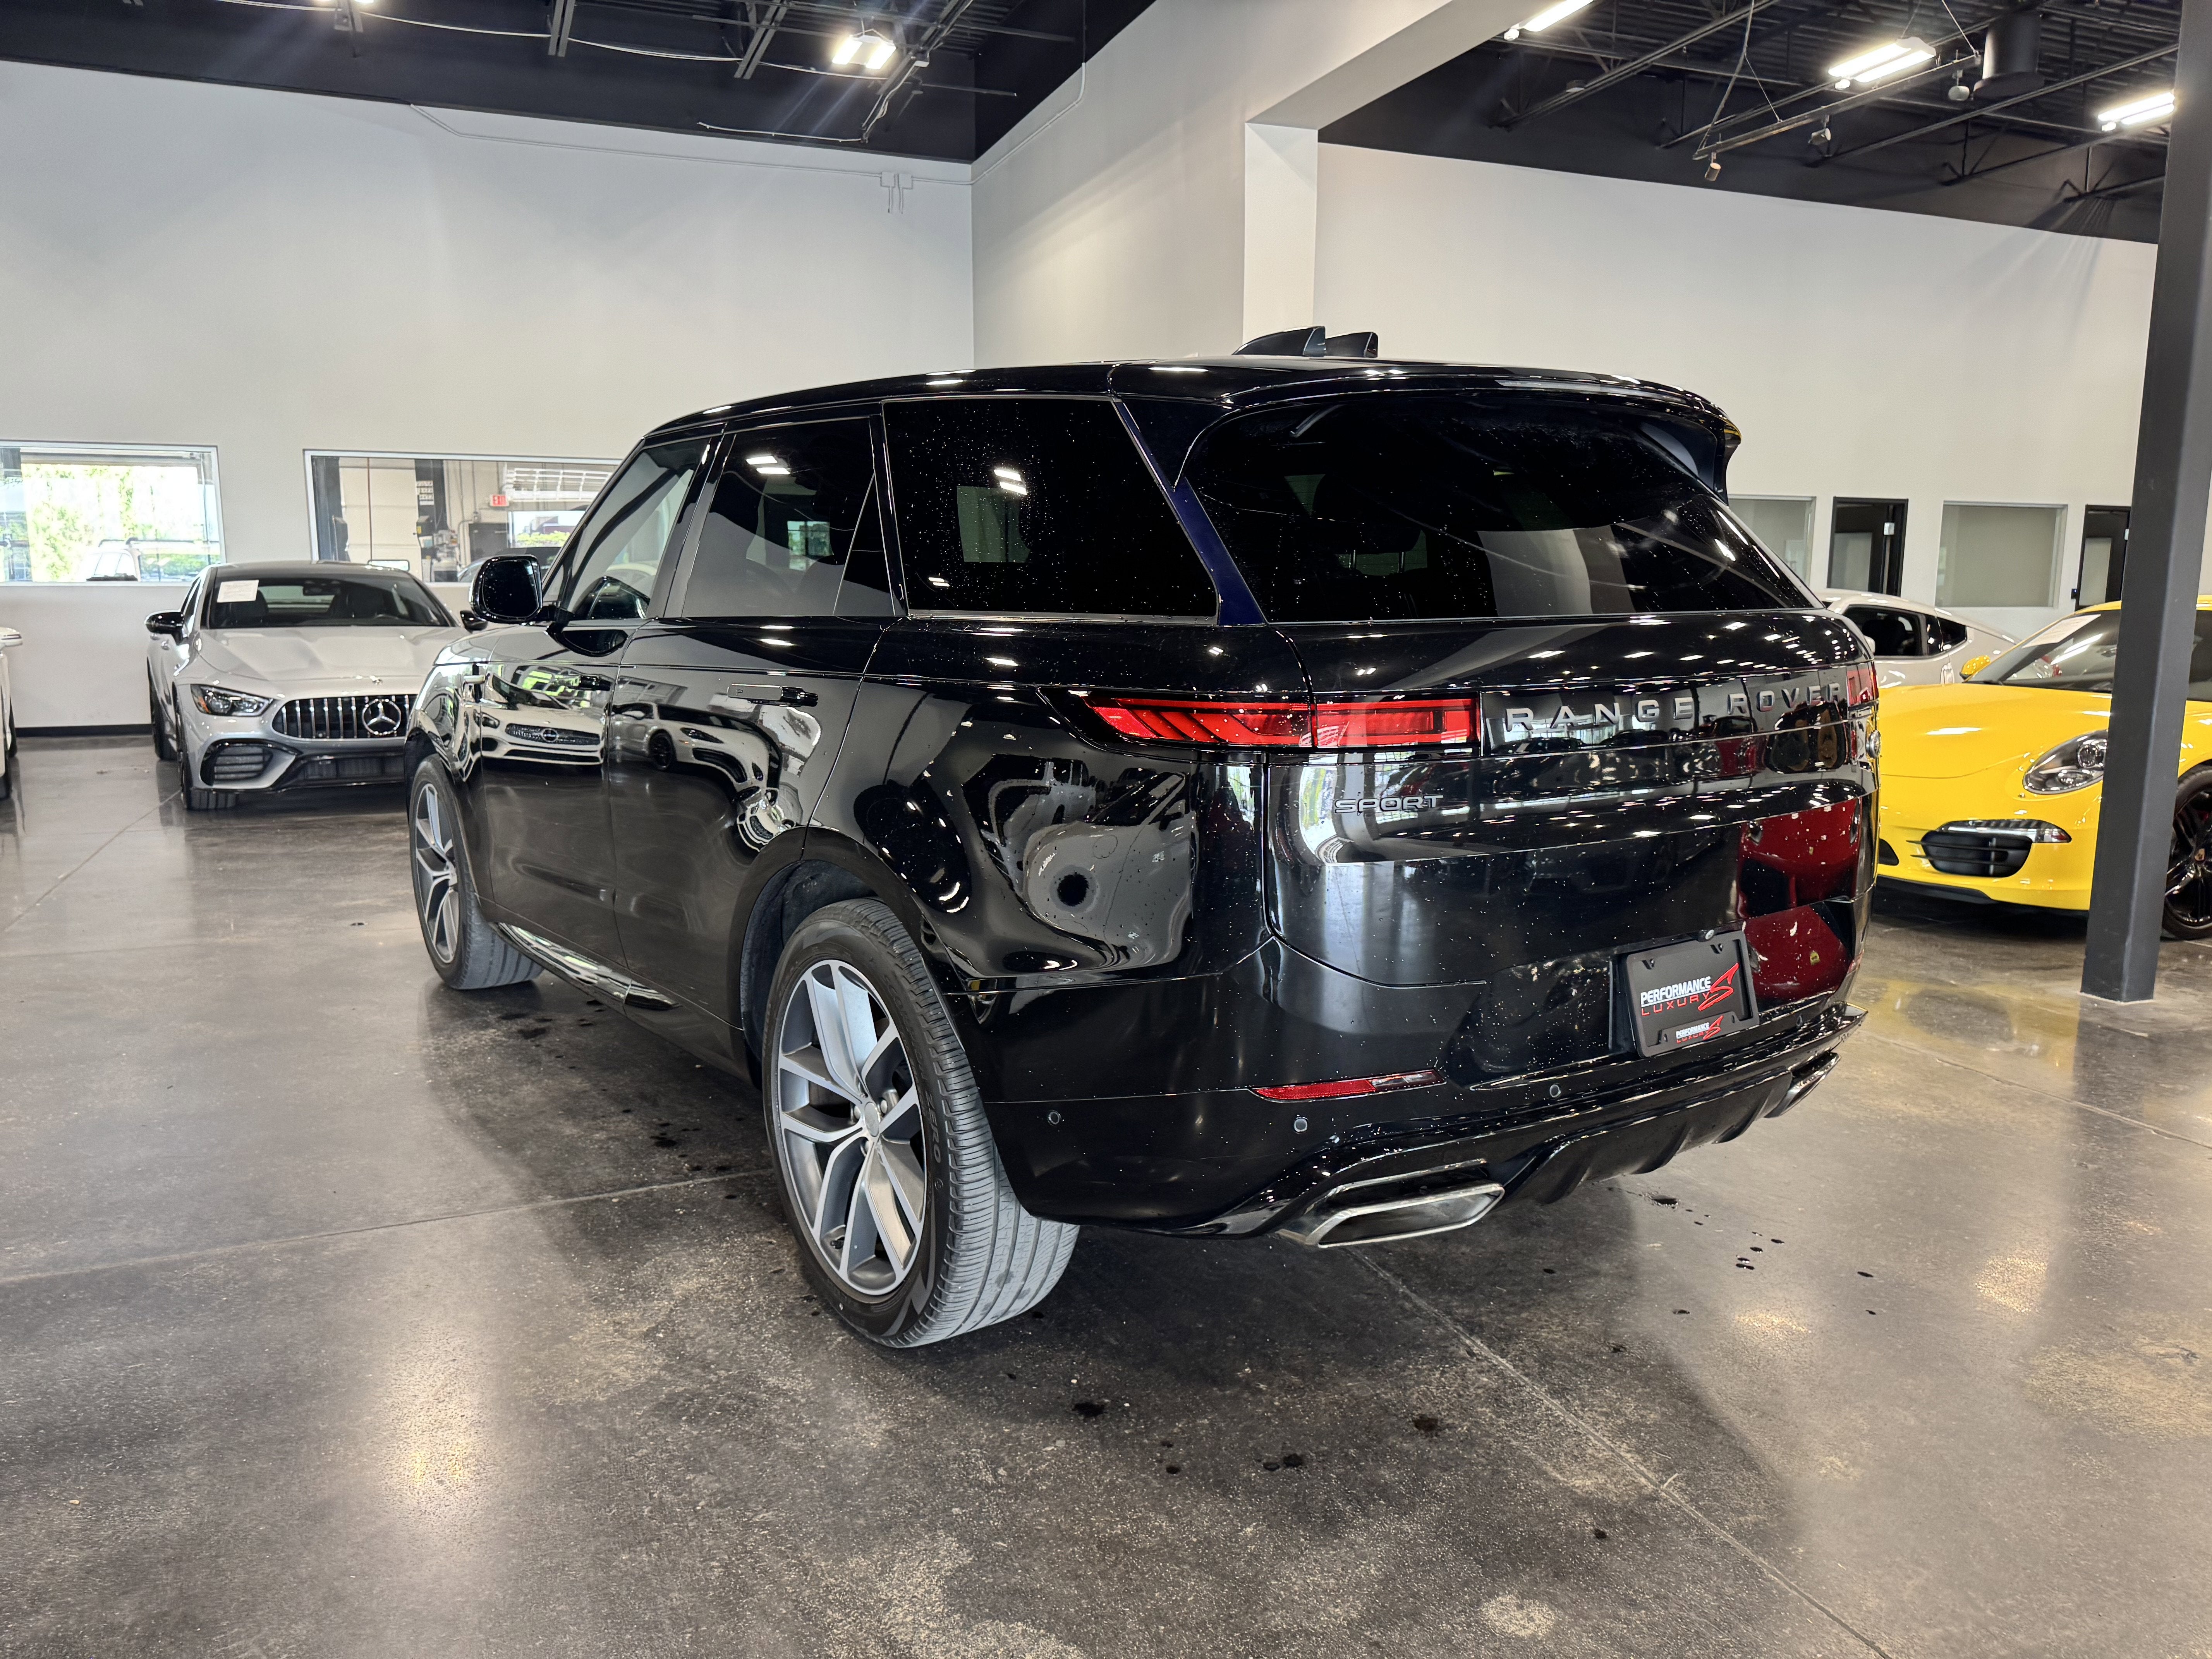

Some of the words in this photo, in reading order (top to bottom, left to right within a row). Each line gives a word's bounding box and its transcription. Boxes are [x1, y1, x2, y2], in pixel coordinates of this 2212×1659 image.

[1505, 697, 1694, 732] RANGE
[1727, 683, 1840, 715] ROVER
[1334, 795, 1444, 814] SPORT
[1640, 976, 1711, 1006] PERFORMANCE
[1641, 991, 1710, 1016] LUXURY
[1676, 1022, 1710, 1039] PERFORMANCE
[925, 1090, 941, 1164] ZERO
